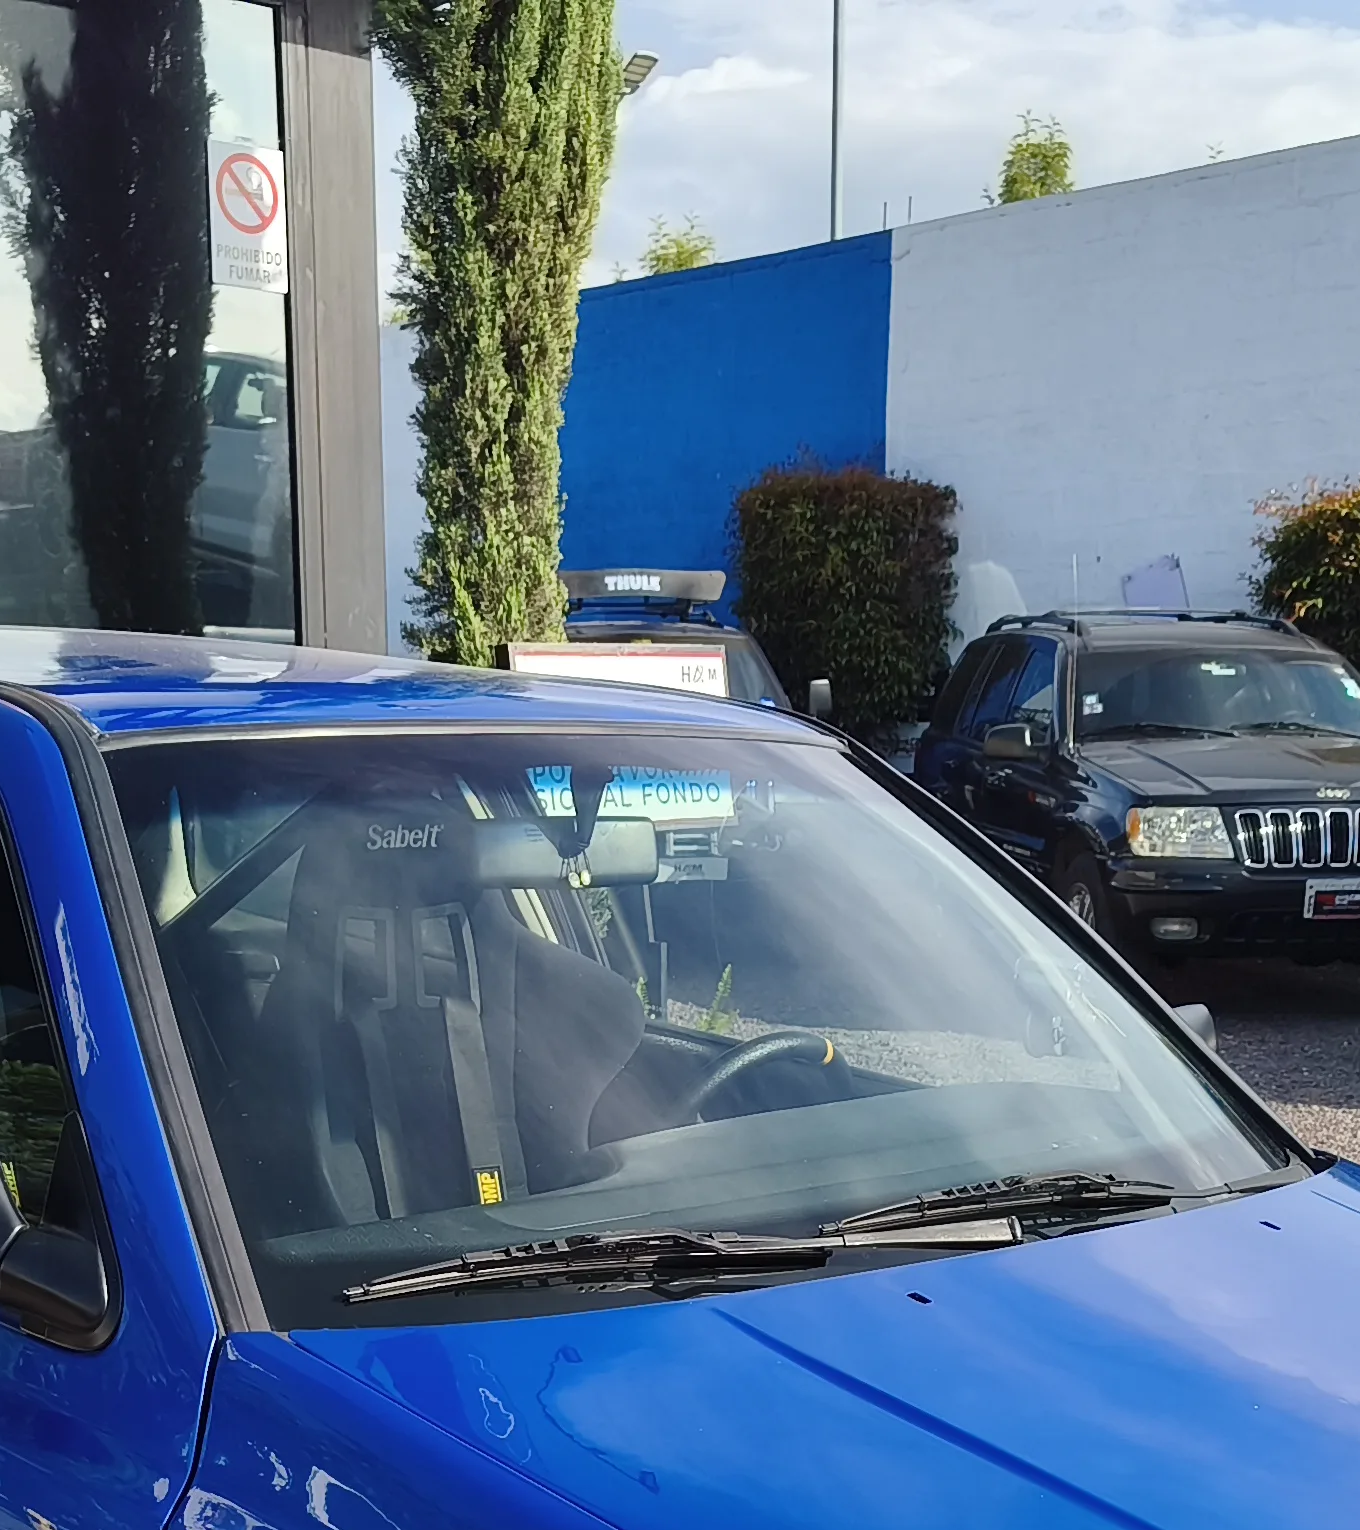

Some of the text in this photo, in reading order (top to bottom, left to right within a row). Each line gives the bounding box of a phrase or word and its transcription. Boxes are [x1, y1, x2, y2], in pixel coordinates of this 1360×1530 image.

[216, 244, 282, 267] PROHIBIDO
[229, 264, 271, 283] FUMAR
[604, 574, 661, 591] THULE
[603, 785, 632, 808] AL
[642, 782, 720, 806] FONDO
[367, 823, 441, 850] Sabelt
